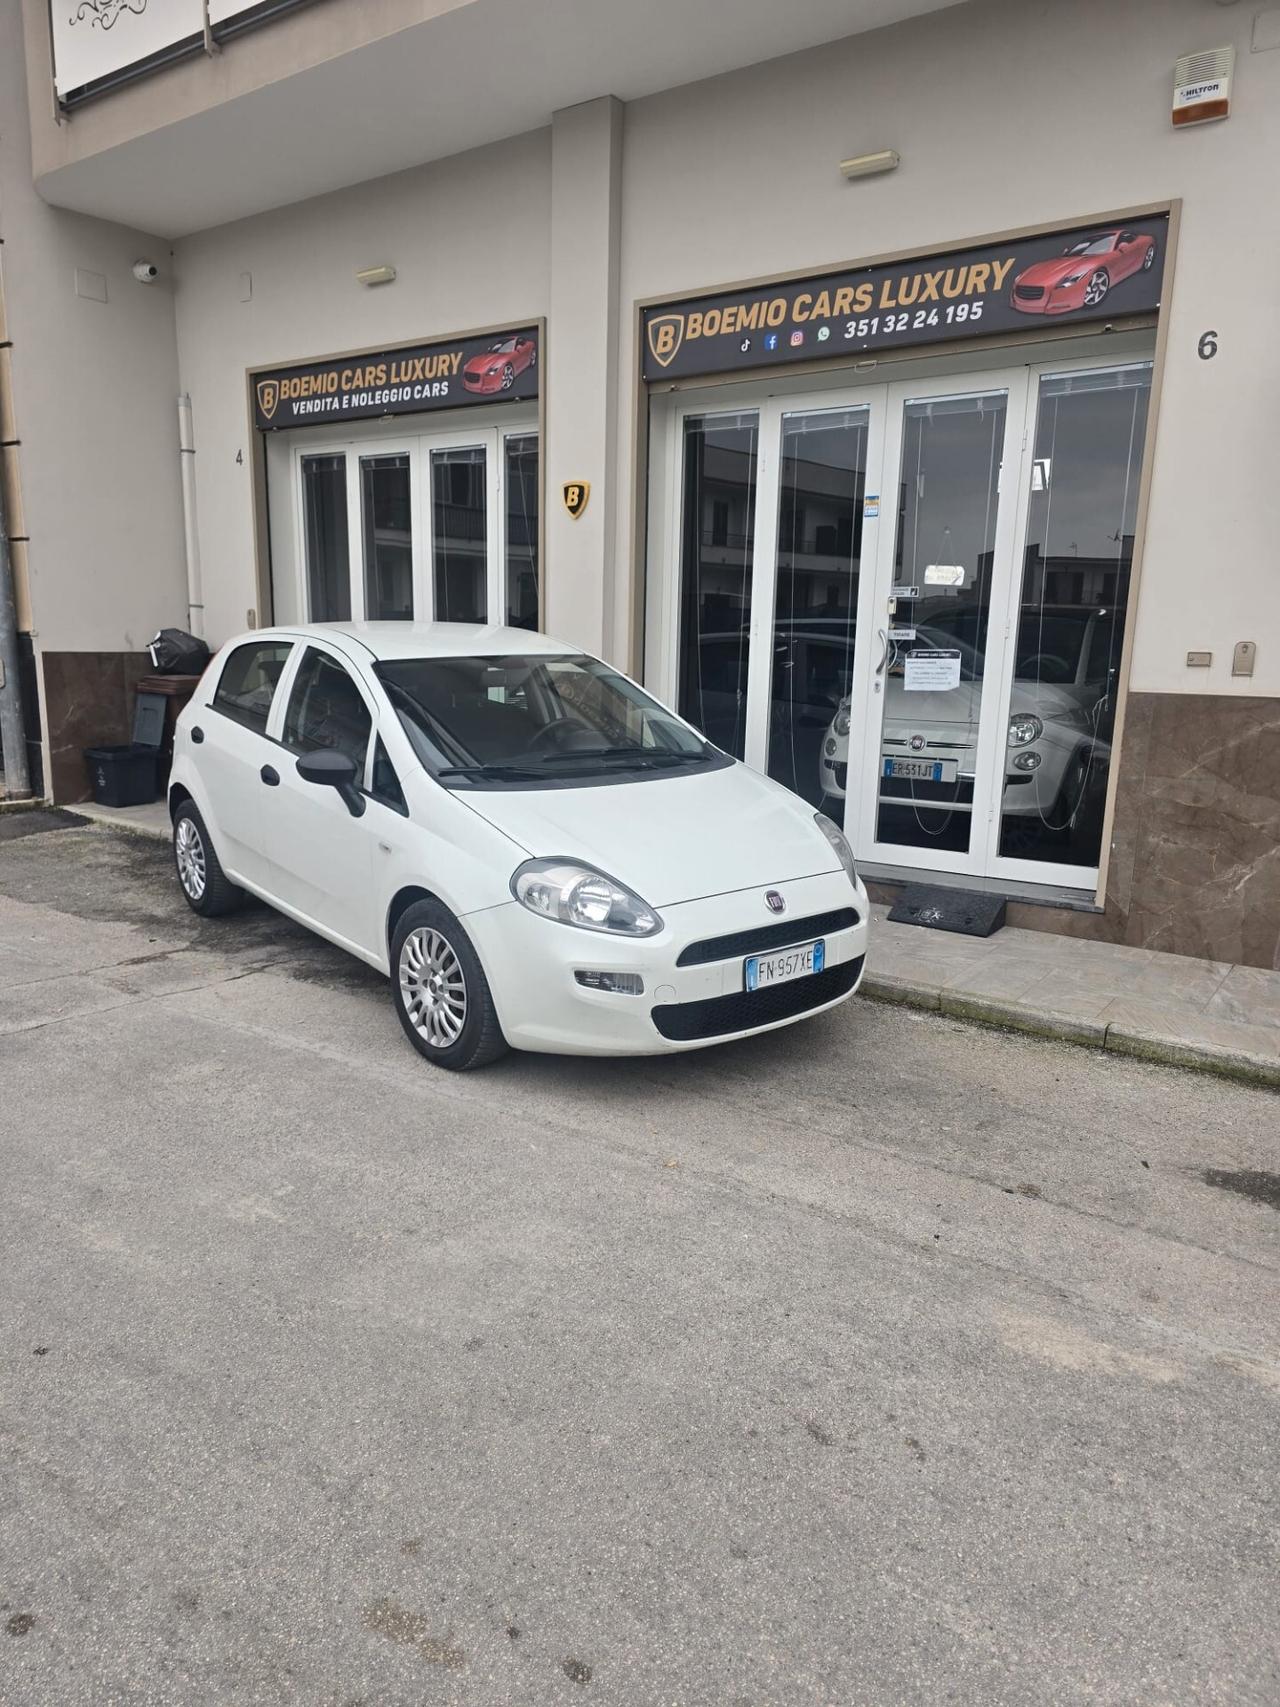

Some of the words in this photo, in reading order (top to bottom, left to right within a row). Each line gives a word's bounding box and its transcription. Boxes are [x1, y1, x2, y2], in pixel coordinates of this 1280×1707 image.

[685, 299, 787, 340] BOEMIO
[792, 283, 874, 323] CARS
[878, 257, 1016, 309] LUXURY
[843, 315, 879, 340] 351
[883, 312, 908, 333] 32
[912, 307, 940, 329] 24
[944, 301, 984, 324] 195
[656, 325, 676, 353] B
[1197, 330, 1218, 360] 6
[280, 371, 338, 400] BOEMIO
[341, 363, 387, 391] CARS
[390, 351, 463, 384] LUXURY
[262, 387, 274, 410] B
[292, 398, 340, 415] VENDITA
[342, 396, 349, 409] E
[351, 386, 411, 407] NOLEGGIO
[413, 381, 449, 400] CARS
[235, 448, 244, 466] 4
[566, 485, 580, 508] B
